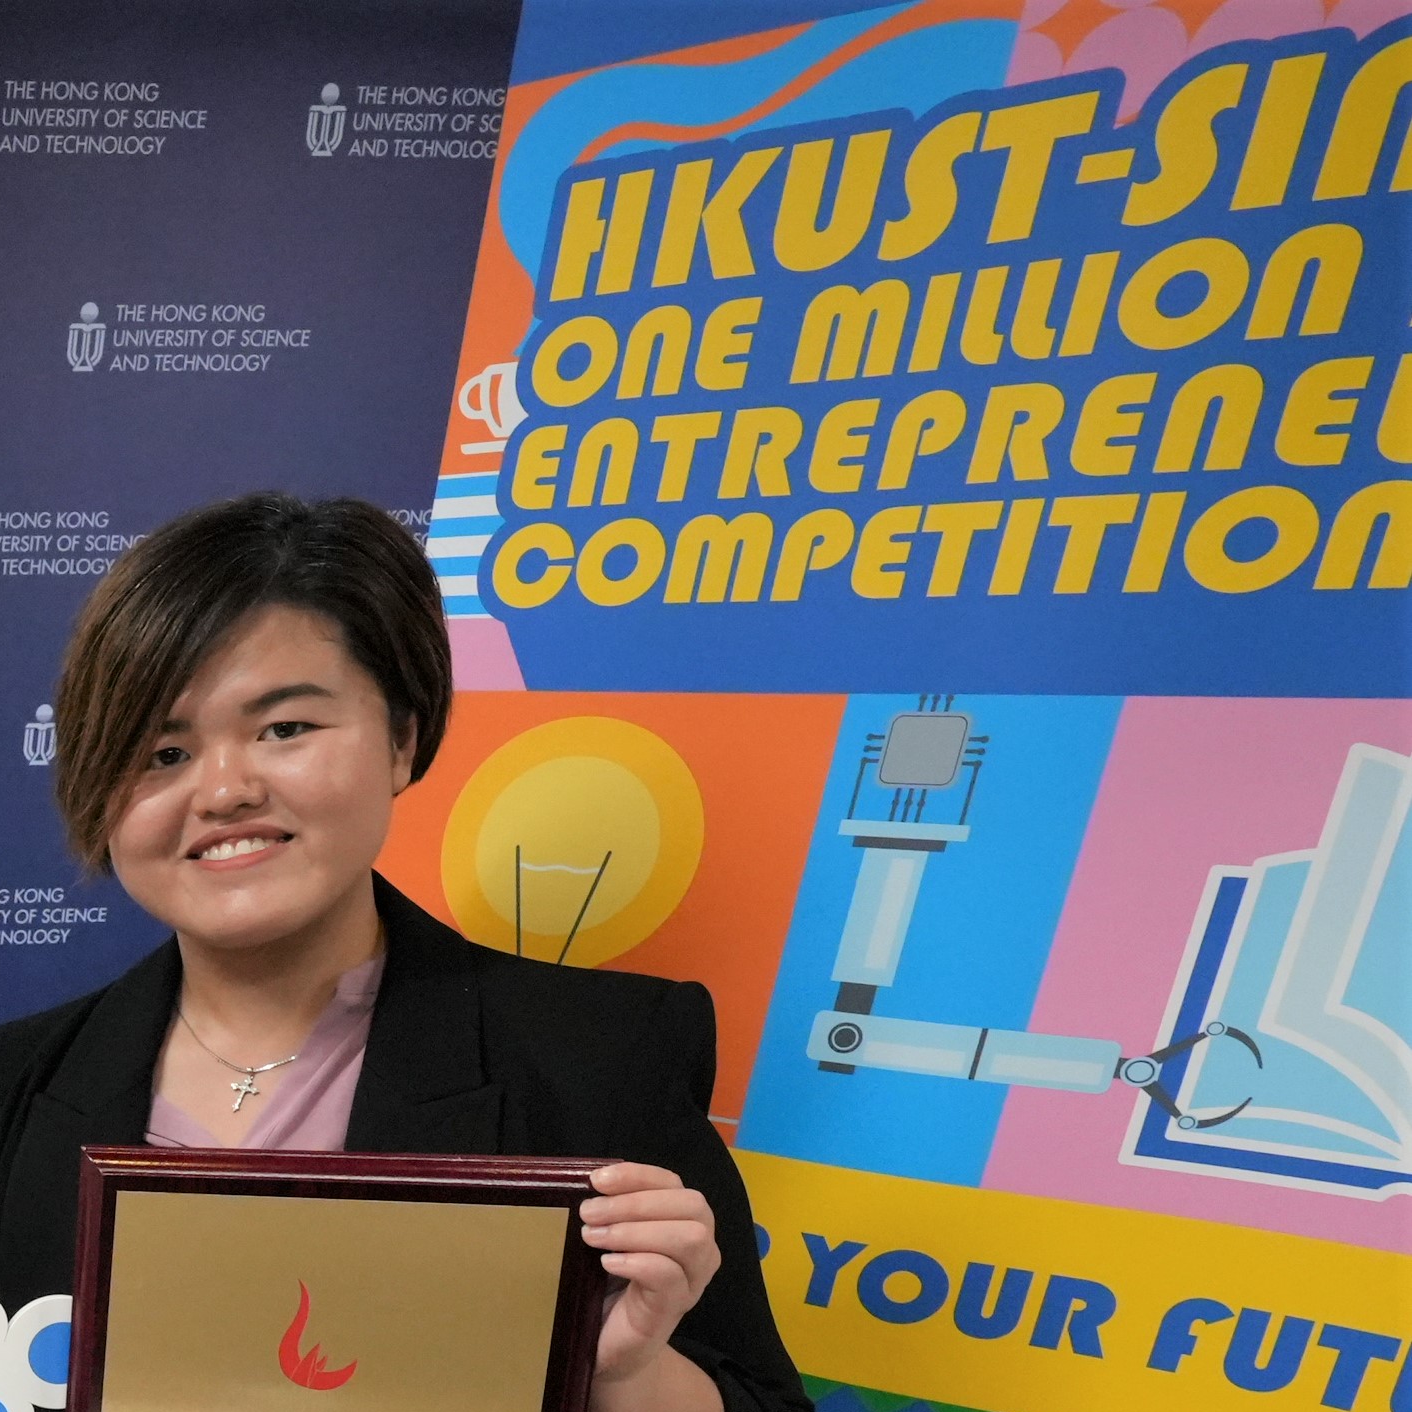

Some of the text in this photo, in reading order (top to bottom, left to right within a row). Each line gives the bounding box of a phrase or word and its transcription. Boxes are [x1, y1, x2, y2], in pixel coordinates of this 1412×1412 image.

[2, 108, 207, 129] UNIVERSITY OF SCIENCE
[5, 80, 159, 102] THE HONG KONG
[0, 135, 166, 154] AND TECHNOLOGY
[532, 222, 1364, 408] ONE MILLION
[492, 480, 1412, 608] COMPETITION
[800, 1231, 1117, 1359] YOUR
